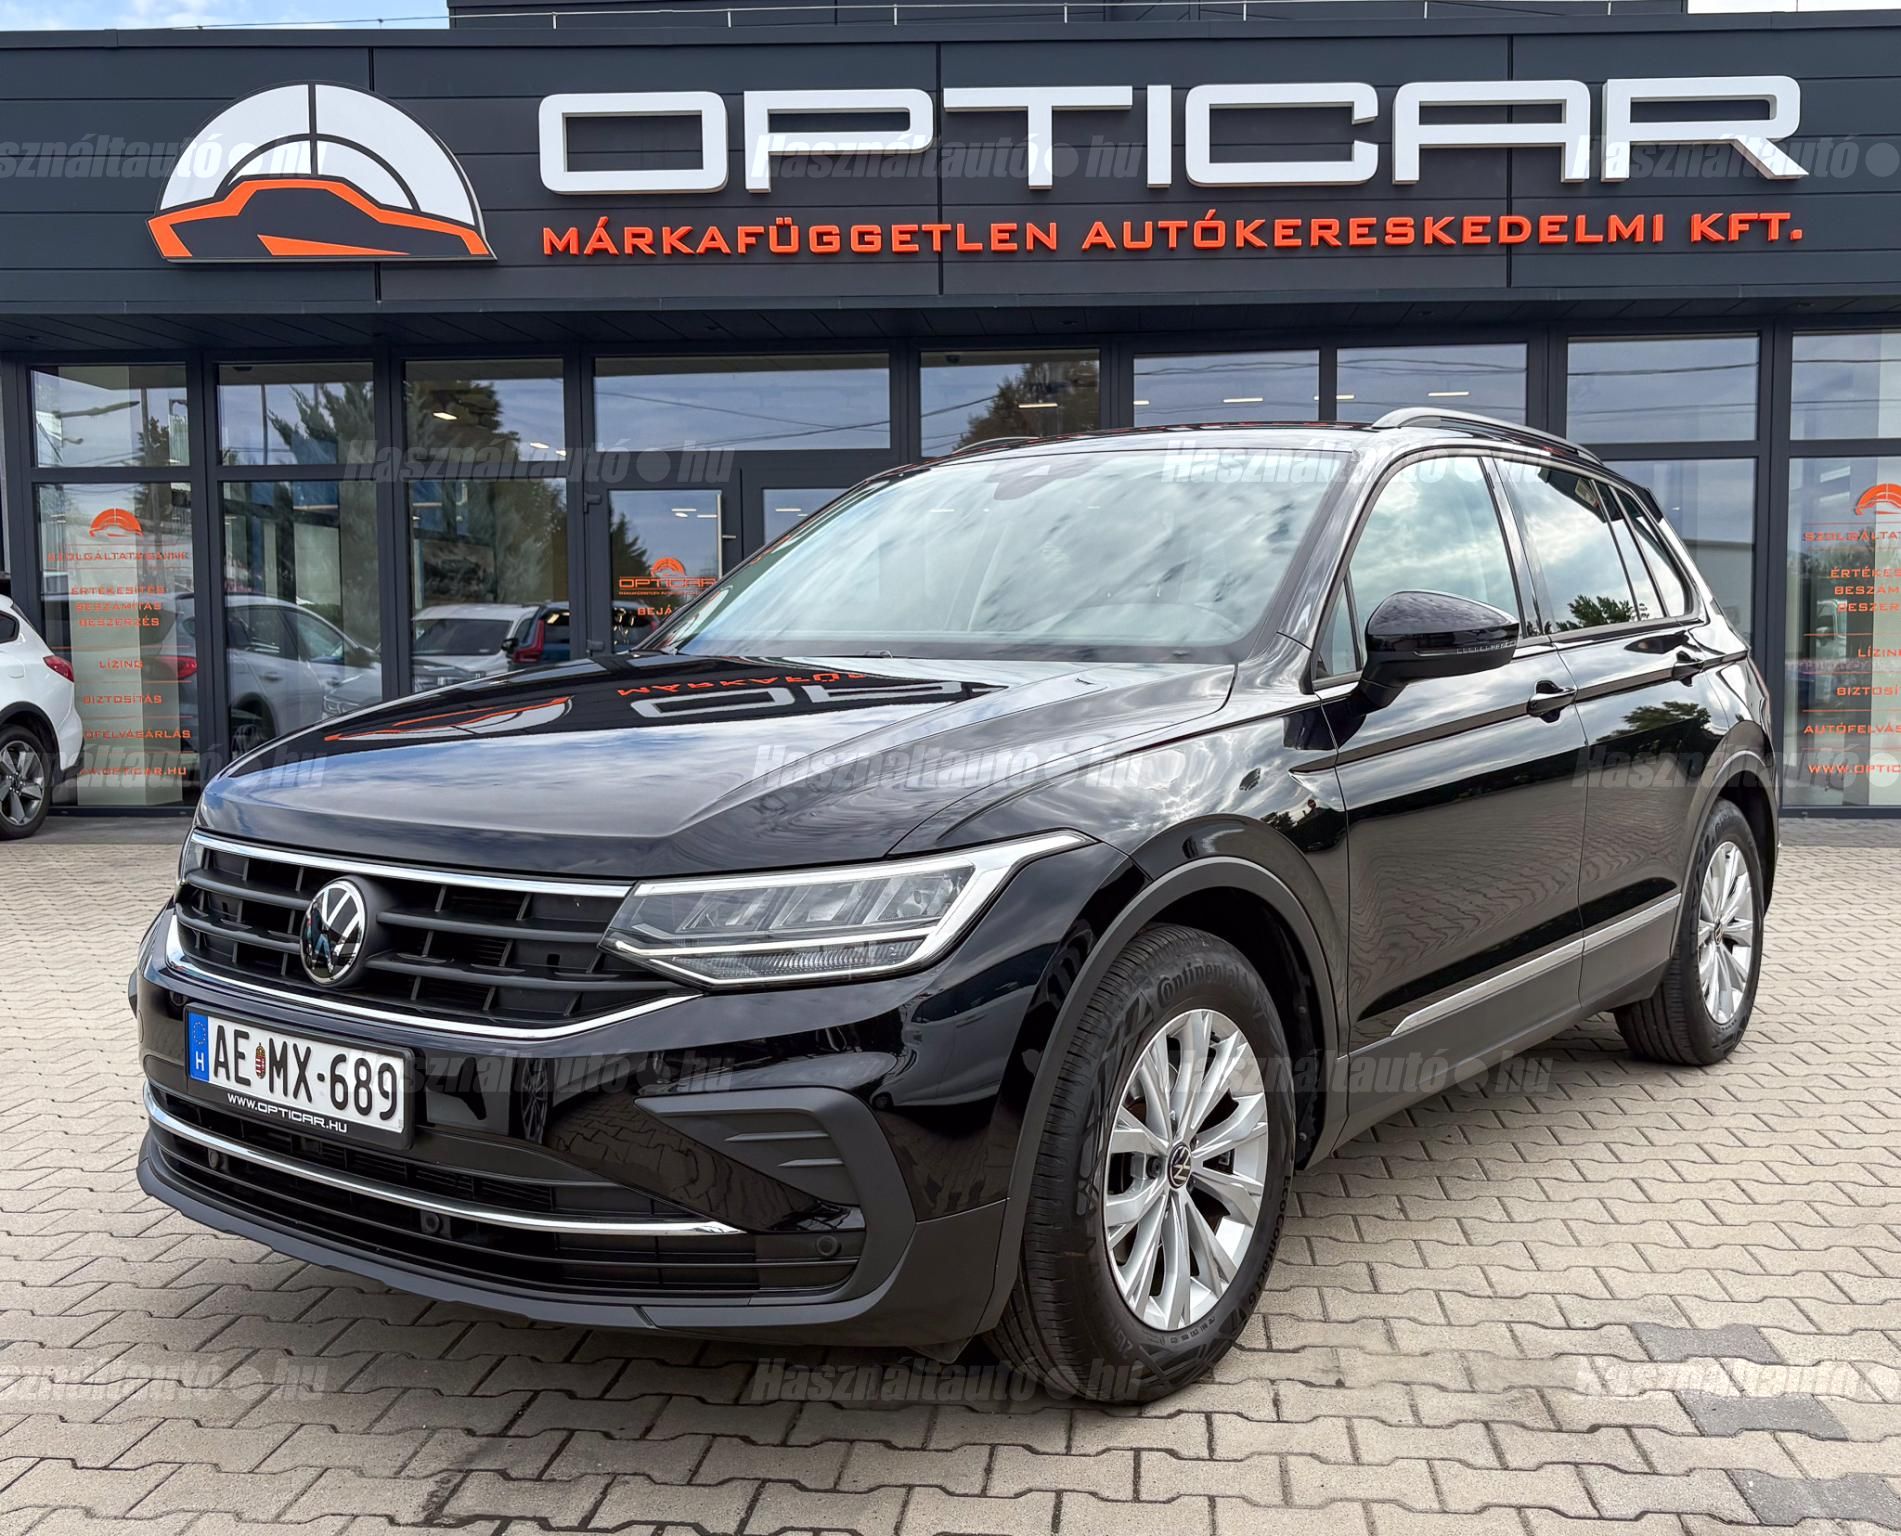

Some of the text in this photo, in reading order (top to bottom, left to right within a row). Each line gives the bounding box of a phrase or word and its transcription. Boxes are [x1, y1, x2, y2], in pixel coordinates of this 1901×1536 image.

[538, 75, 1810, 195] OPTICAR
[543, 209, 1804, 256] MÁRKAFÜGGETLEN AUTÓKERESKEDELMI KFT.
[194, 1050, 206, 1072] H
[213, 1024, 252, 1087] AE
[226, 1092, 349, 1134] WWW.OPTICAR.HU
